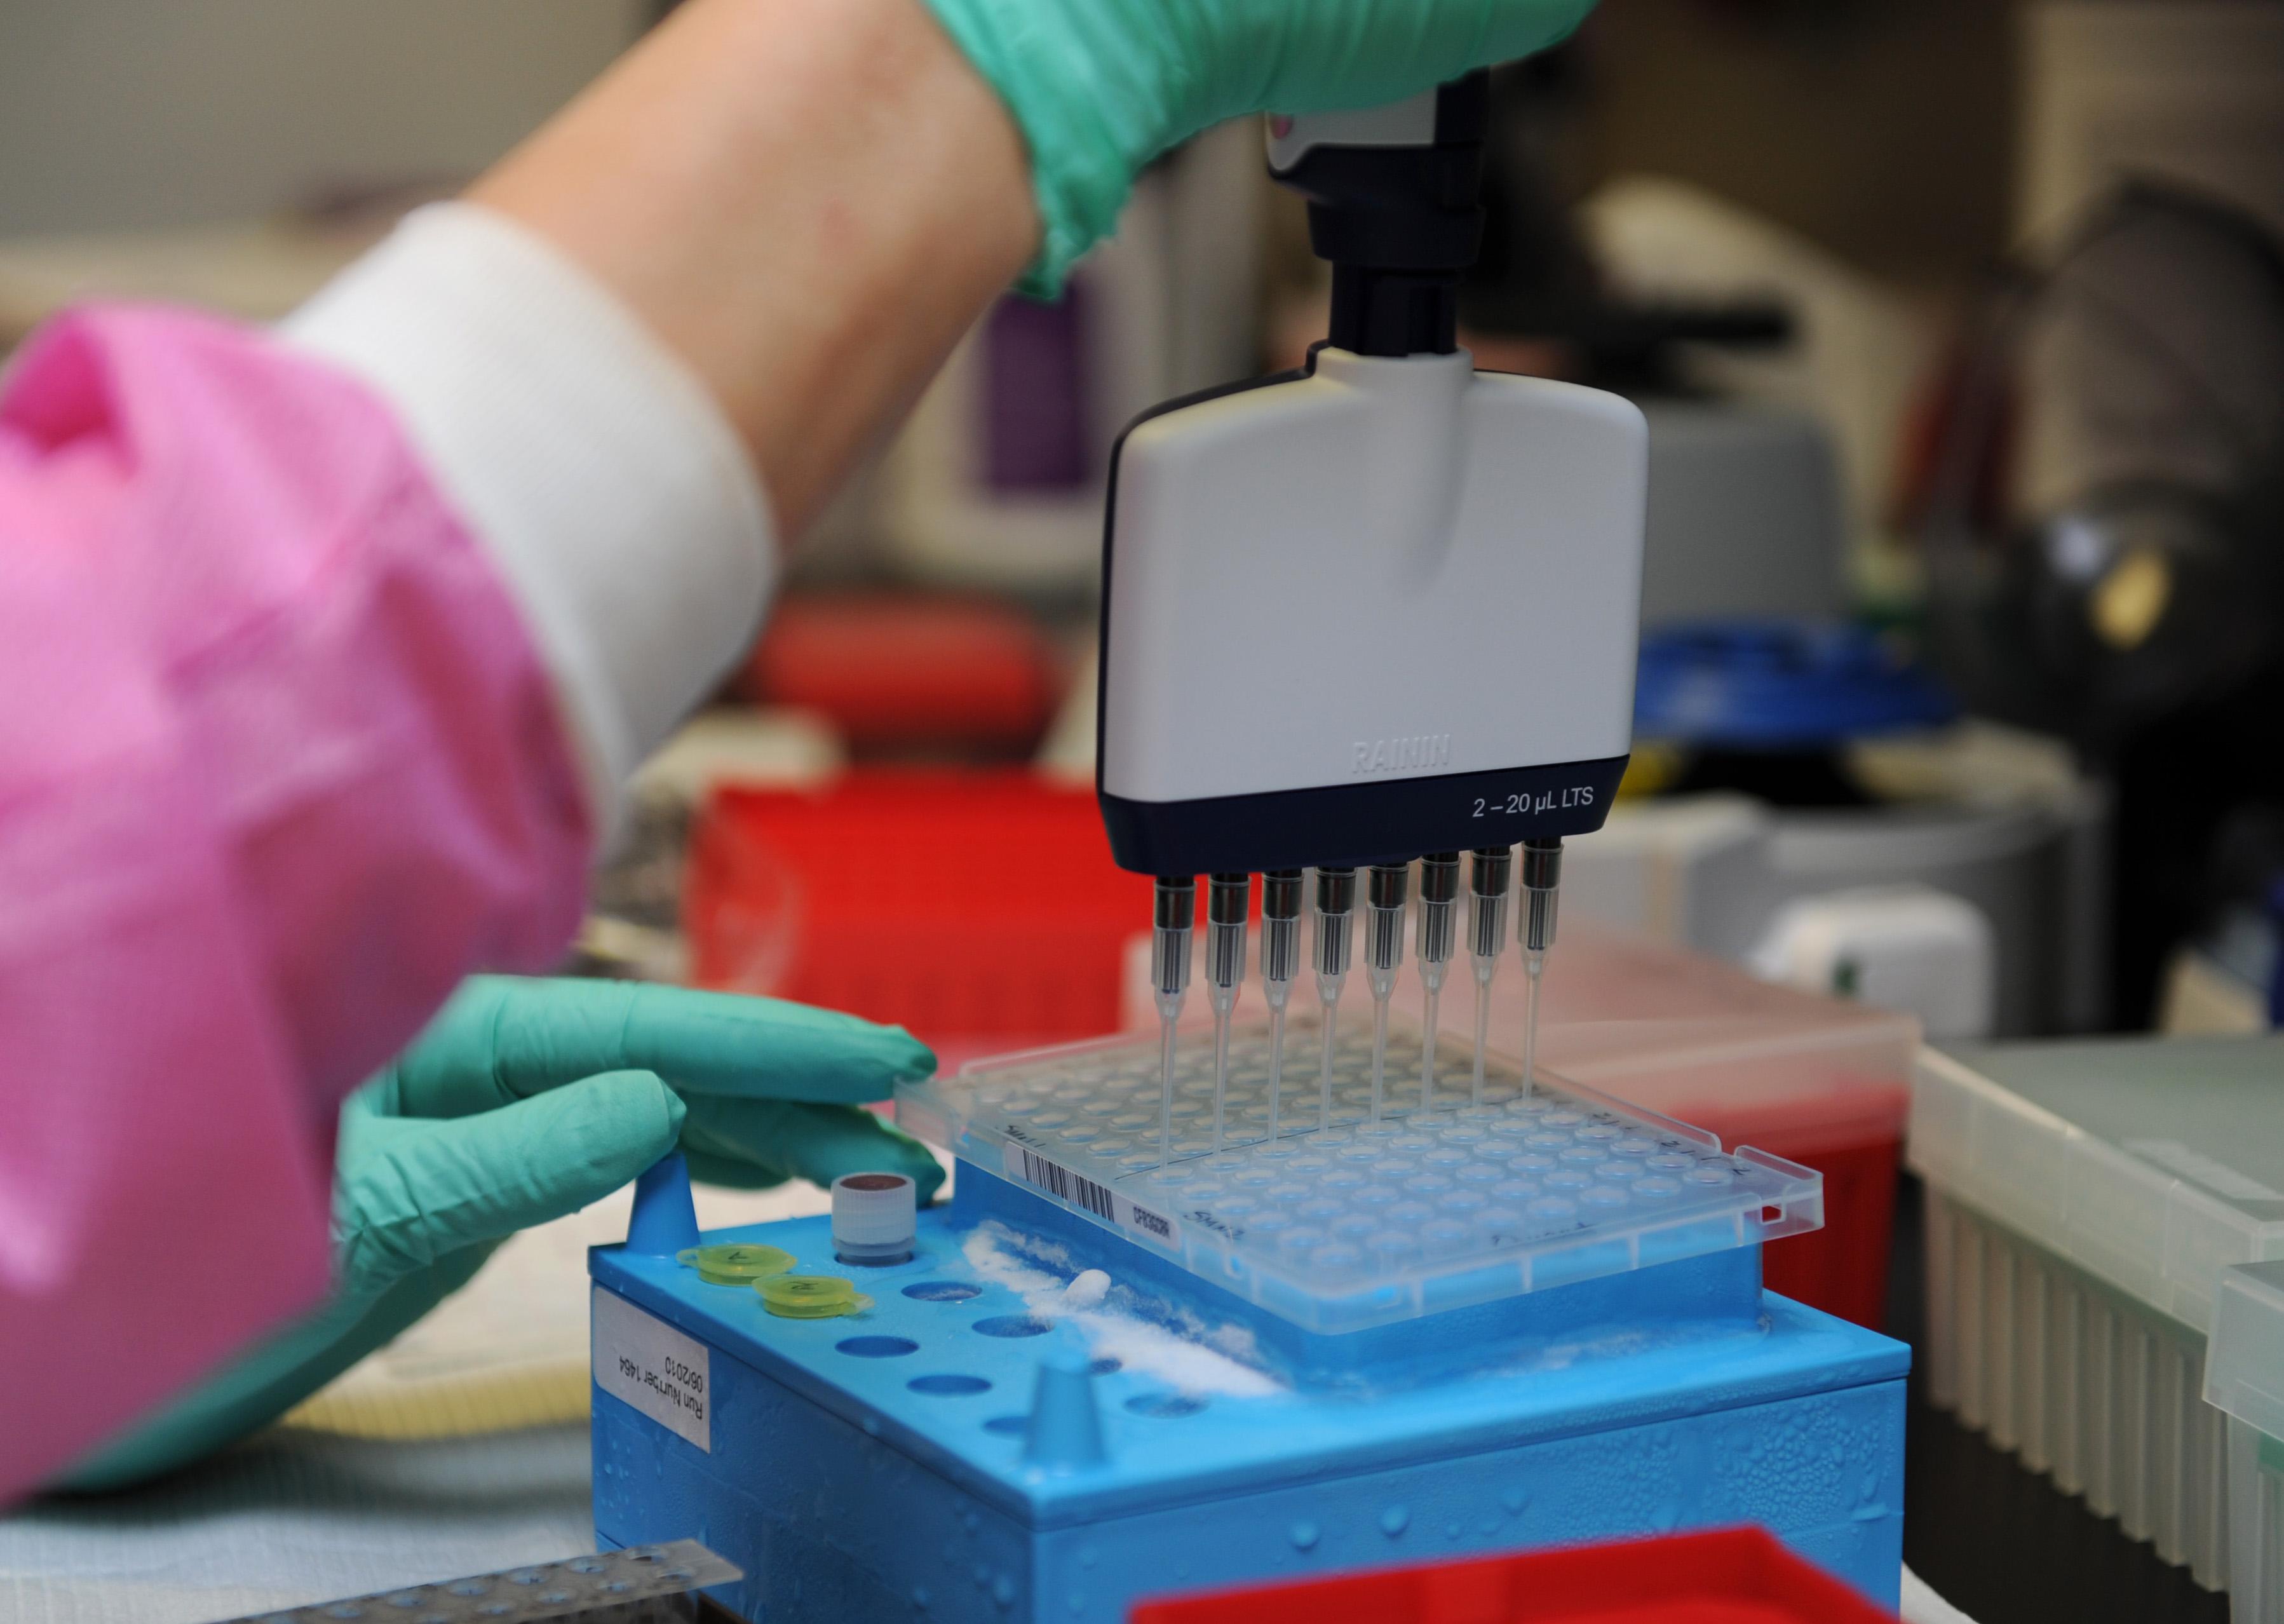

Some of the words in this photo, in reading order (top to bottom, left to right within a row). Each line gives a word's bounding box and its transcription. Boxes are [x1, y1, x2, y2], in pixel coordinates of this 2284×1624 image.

[1353, 734, 1451, 774] RAININ
[1562, 786, 1593, 808] LTS
[619, 1355, 641, 1383] 1464
[665, 1357, 703, 1393] 06/2010
[643, 1370, 680, 1407] Number
[683, 1392, 703, 1420] Run
